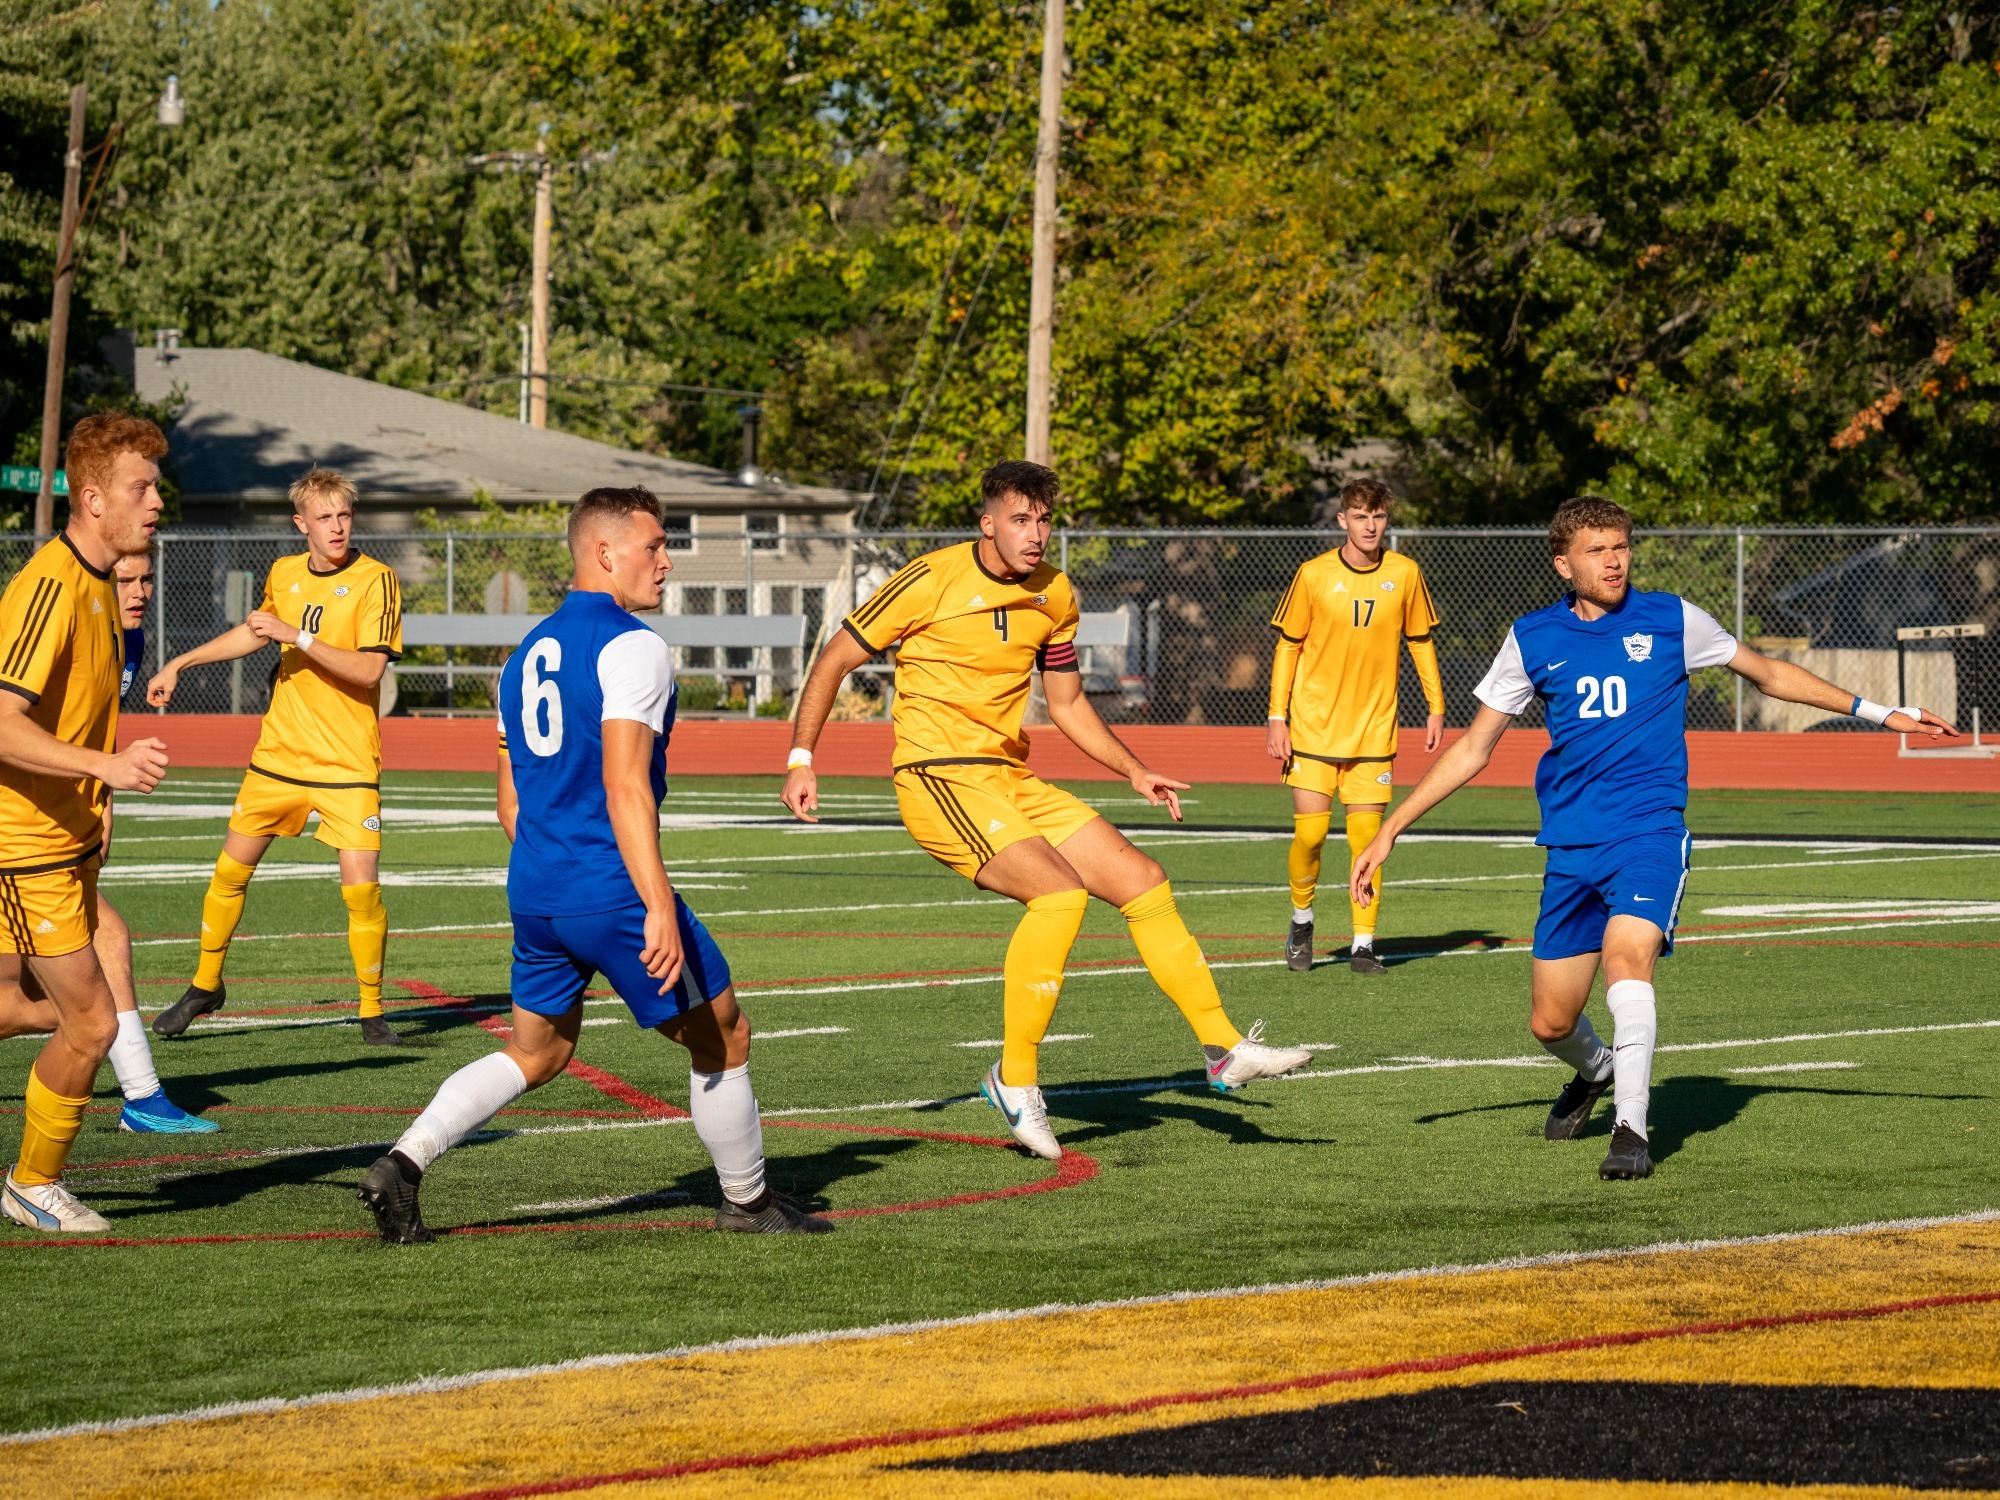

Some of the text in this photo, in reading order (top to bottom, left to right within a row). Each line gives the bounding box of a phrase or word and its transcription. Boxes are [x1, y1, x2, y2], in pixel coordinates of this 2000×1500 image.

[28, 471, 40, 488] ST
[301, 603, 324, 635] 10
[992, 605, 1009, 643] 4
[1352, 598, 1376, 628] 17
[521, 636, 564, 757] 6
[1576, 675, 1627, 719] 20
